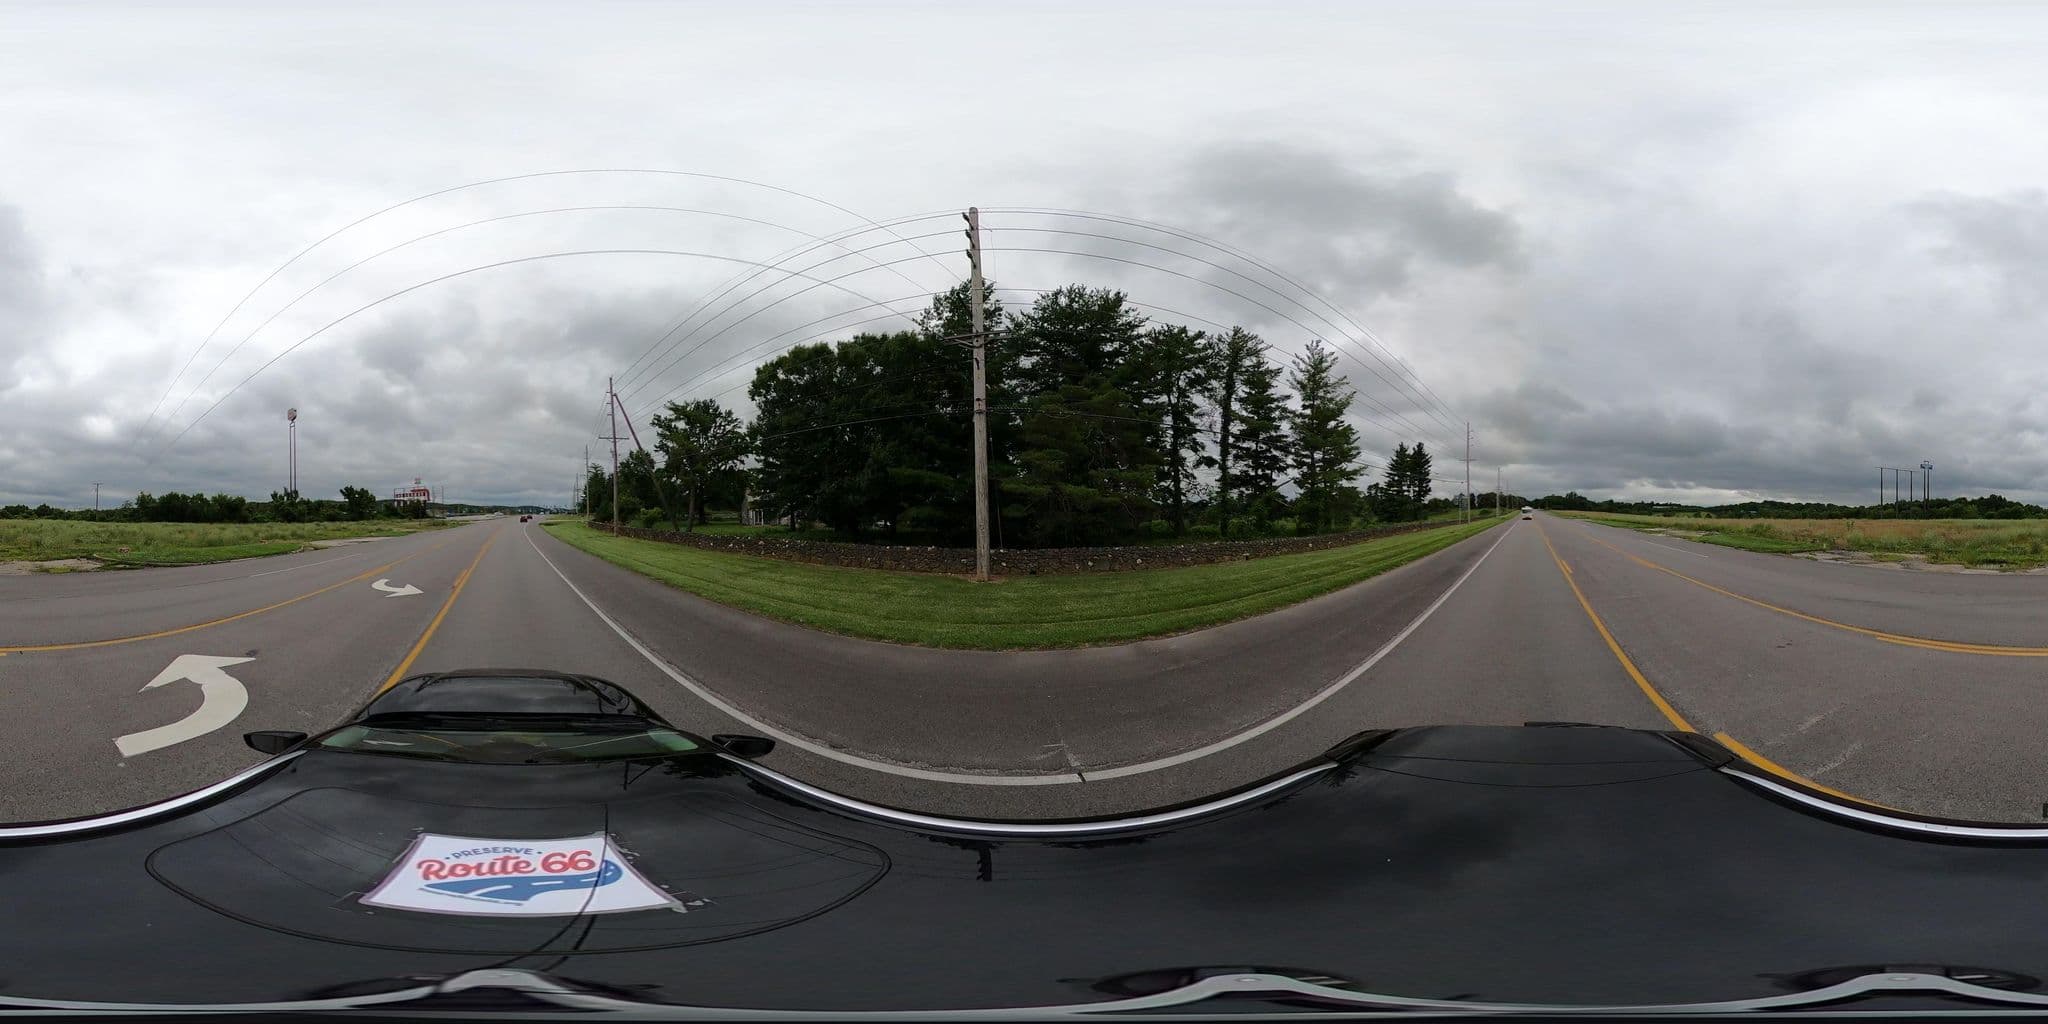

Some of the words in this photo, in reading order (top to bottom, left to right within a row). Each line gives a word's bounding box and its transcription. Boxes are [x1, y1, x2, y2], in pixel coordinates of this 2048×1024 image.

[452, 847, 534, 860] PRESERVE
[417, 856, 536, 880] Route
[540, 850, 596, 873] 66
